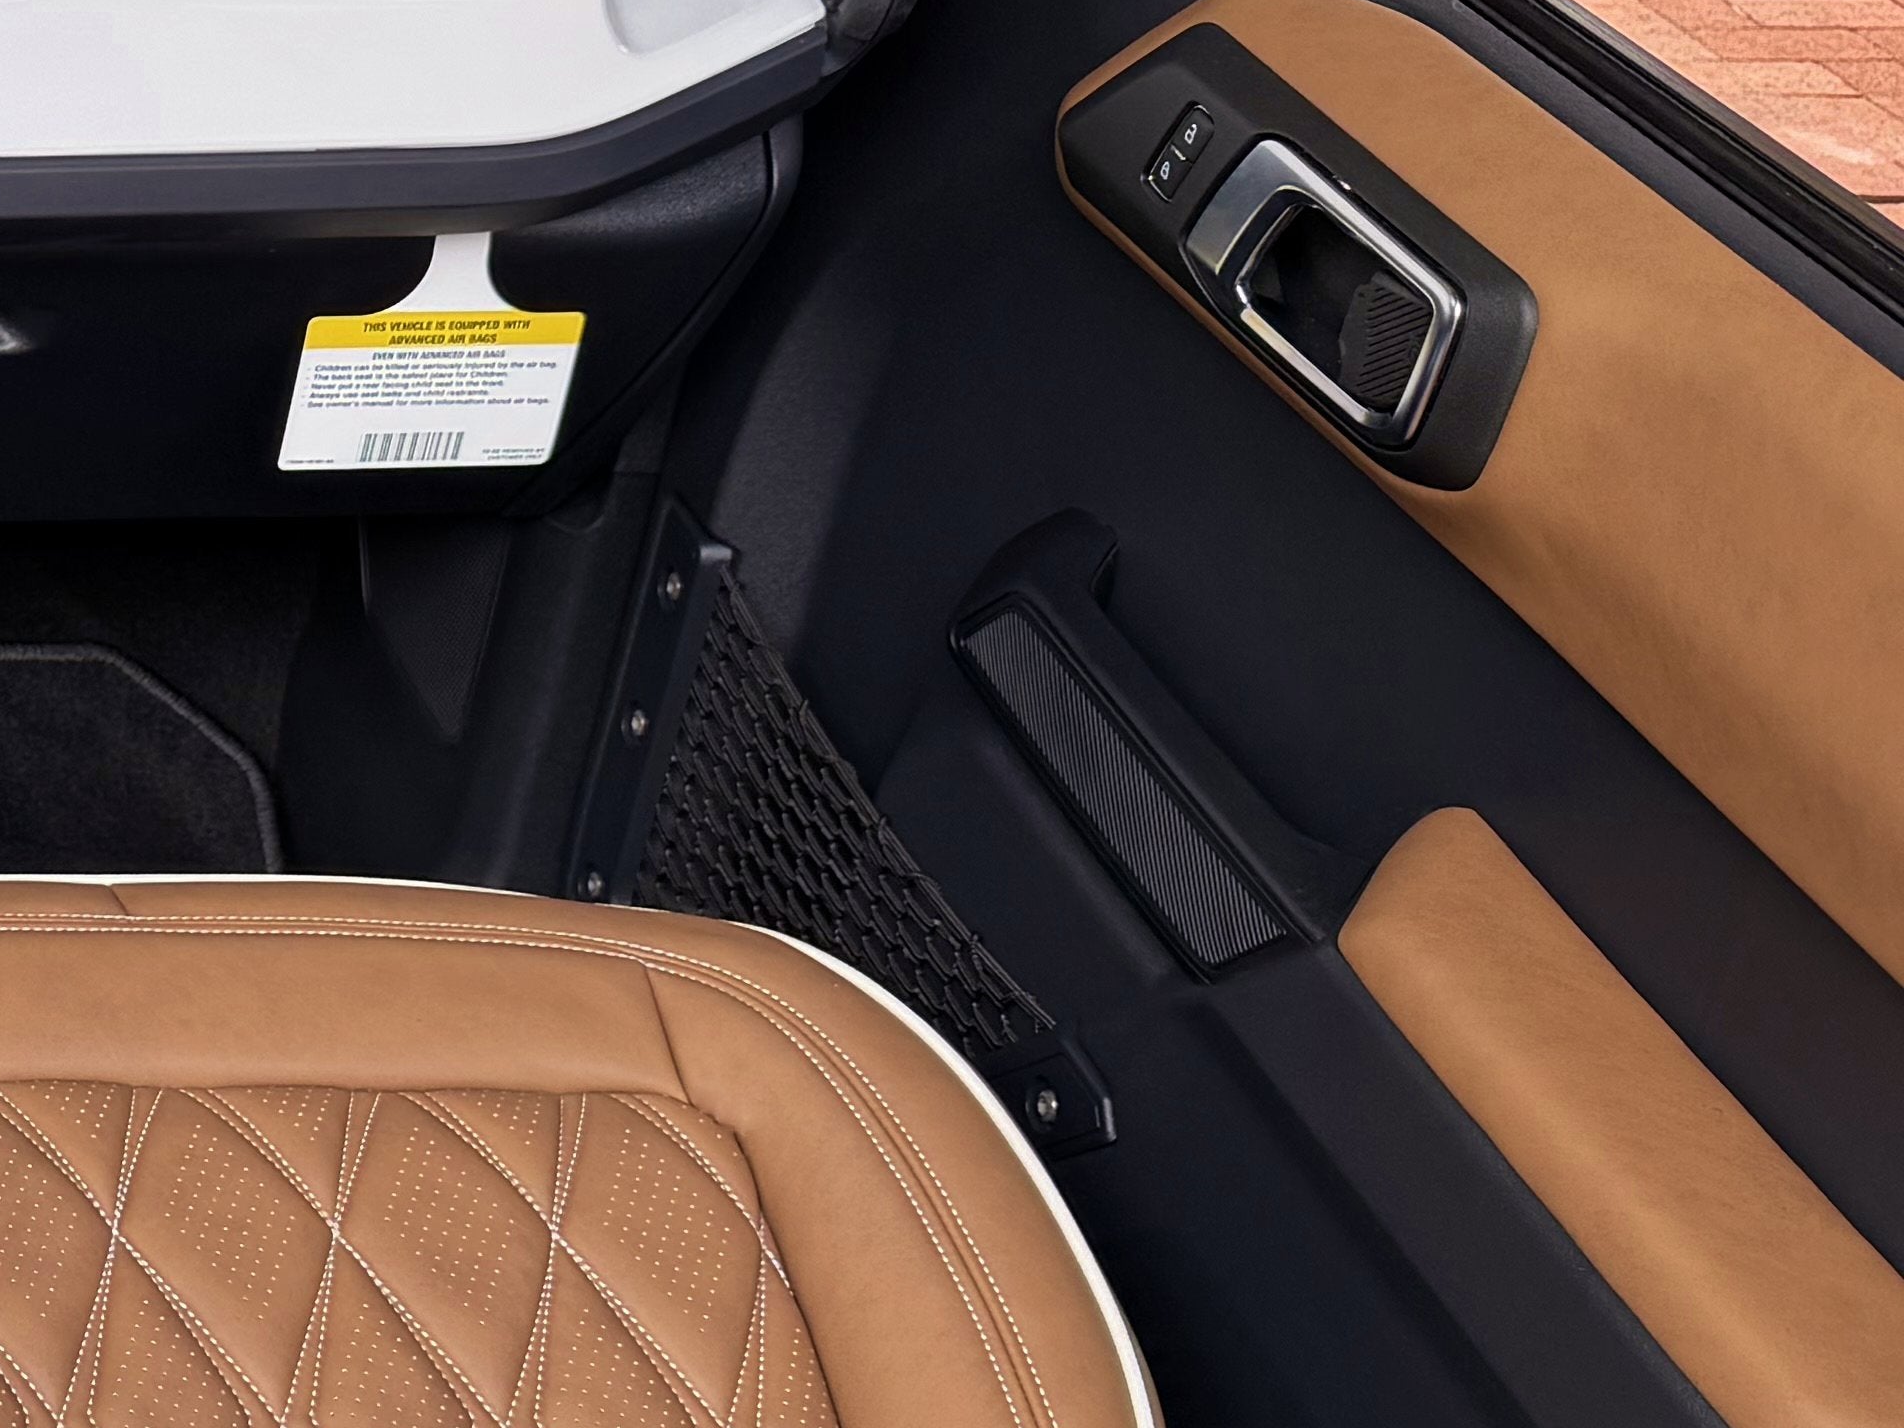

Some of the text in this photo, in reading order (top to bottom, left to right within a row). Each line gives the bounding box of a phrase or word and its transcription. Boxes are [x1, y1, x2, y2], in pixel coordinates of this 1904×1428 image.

[364, 320, 530, 333] THIS VEHICLE IS EQUIPPED WITH
[389, 334, 497, 345] ADVANCED AIR BAGS
[372, 352, 394, 361] EVEN
